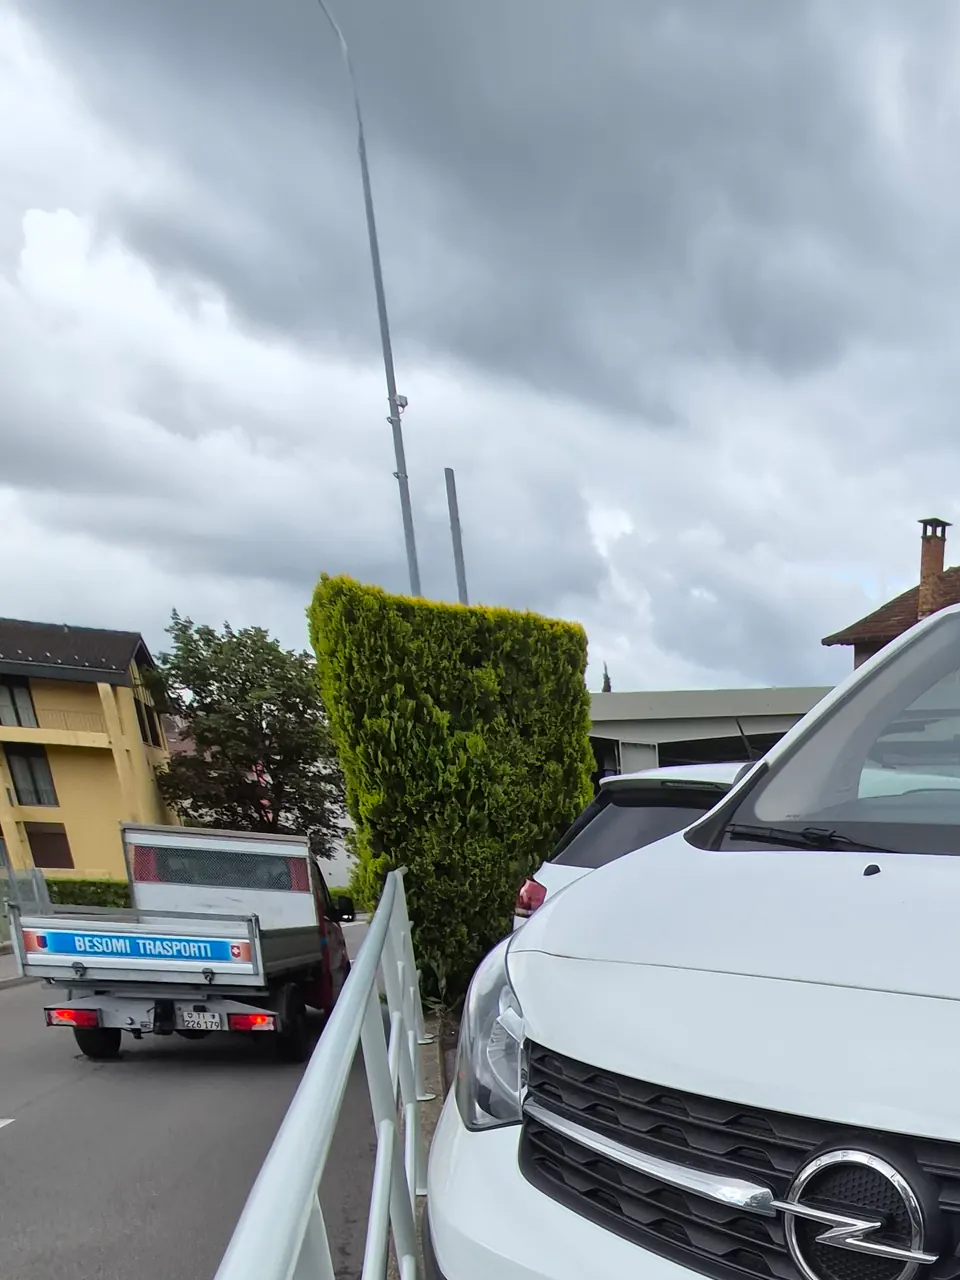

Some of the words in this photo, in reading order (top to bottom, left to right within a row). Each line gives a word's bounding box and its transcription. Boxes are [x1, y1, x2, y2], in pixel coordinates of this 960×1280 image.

[74, 936, 131, 954] BESOMI
[136, 939, 212, 957] TRASPORTI
[814, 1150, 898, 1183] OPEL
